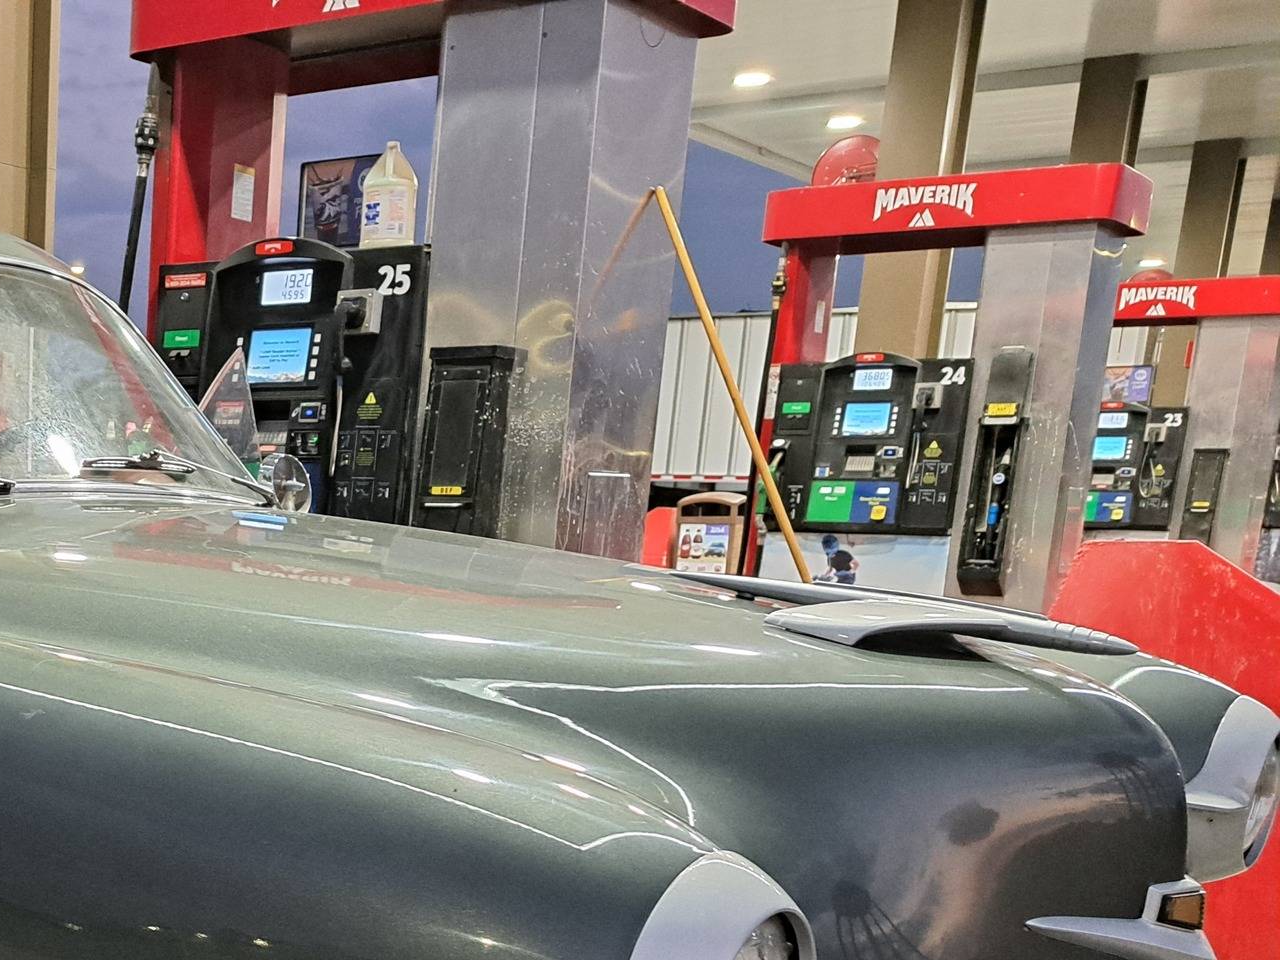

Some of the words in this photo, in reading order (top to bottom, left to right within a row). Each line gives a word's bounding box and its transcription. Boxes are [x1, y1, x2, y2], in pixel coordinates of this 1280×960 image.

[873, 183, 978, 222] MAVERIK
[377, 263, 412, 296] 25
[1118, 285, 1198, 311] MAVERIK
[939, 366, 966, 385] 24
[1163, 413, 1183, 427] 23
